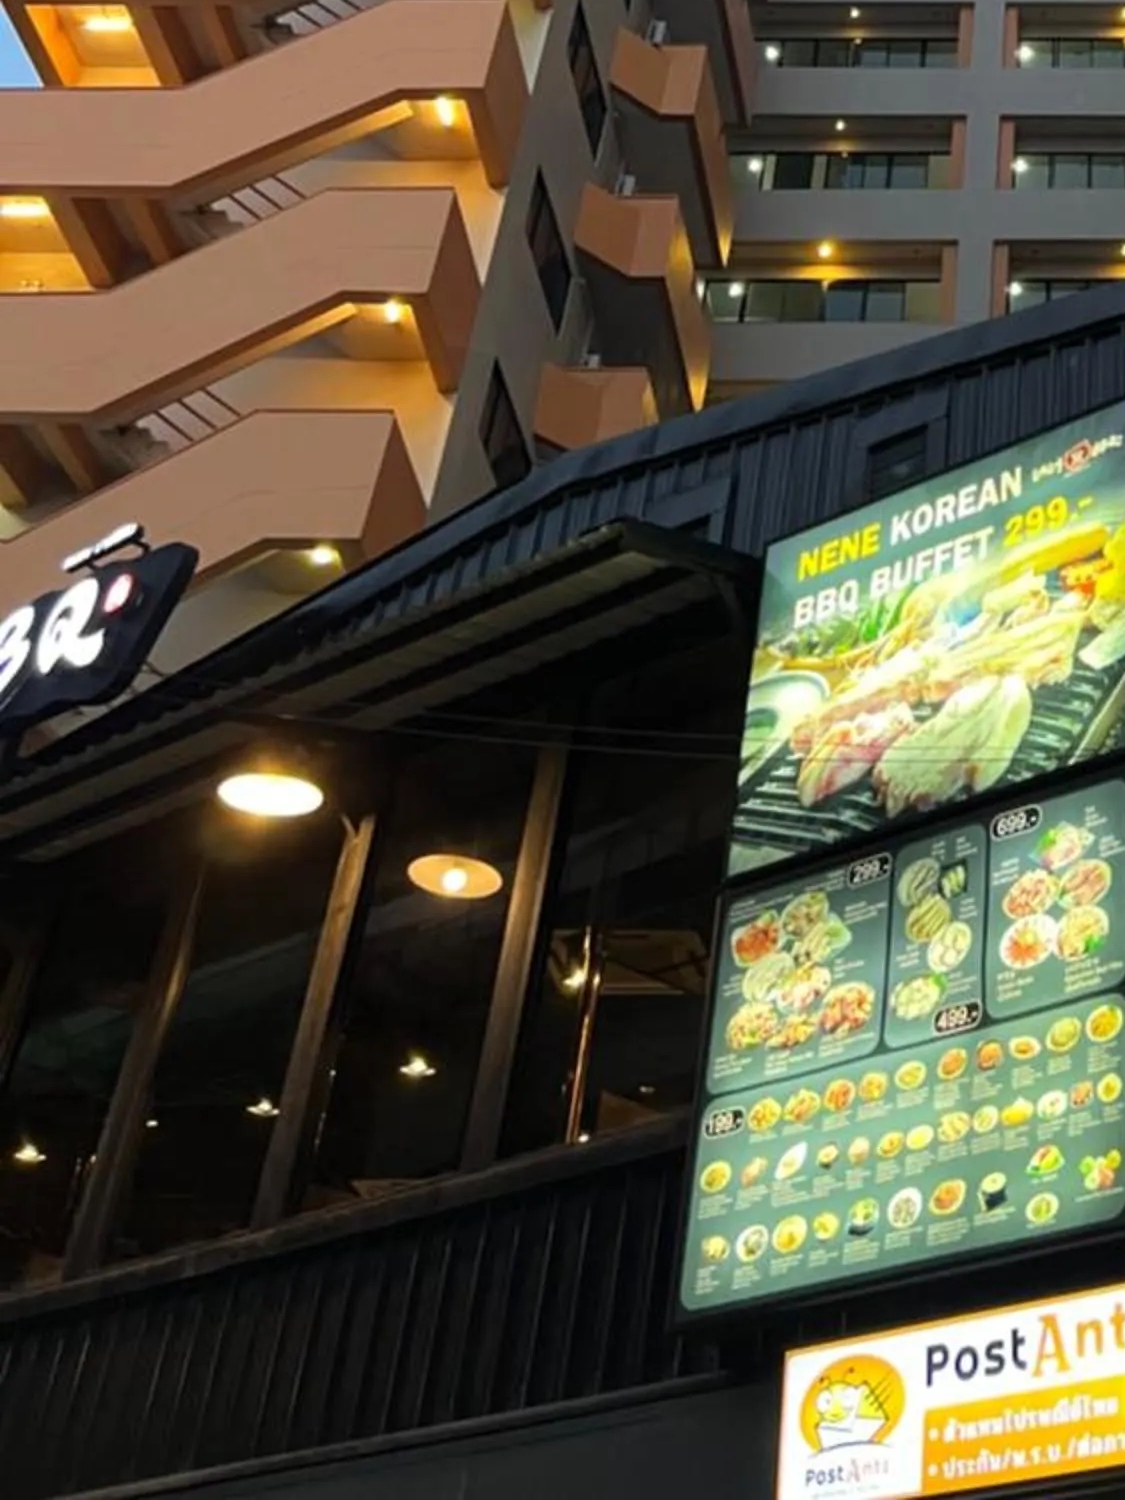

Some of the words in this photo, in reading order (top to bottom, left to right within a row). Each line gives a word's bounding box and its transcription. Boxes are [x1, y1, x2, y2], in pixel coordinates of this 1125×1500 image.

[797, 521, 882, 581] NENE
[890, 466, 1024, 547] KOREAN
[794, 577, 859, 630] BBQ
[869, 527, 996, 597] BUFFET
